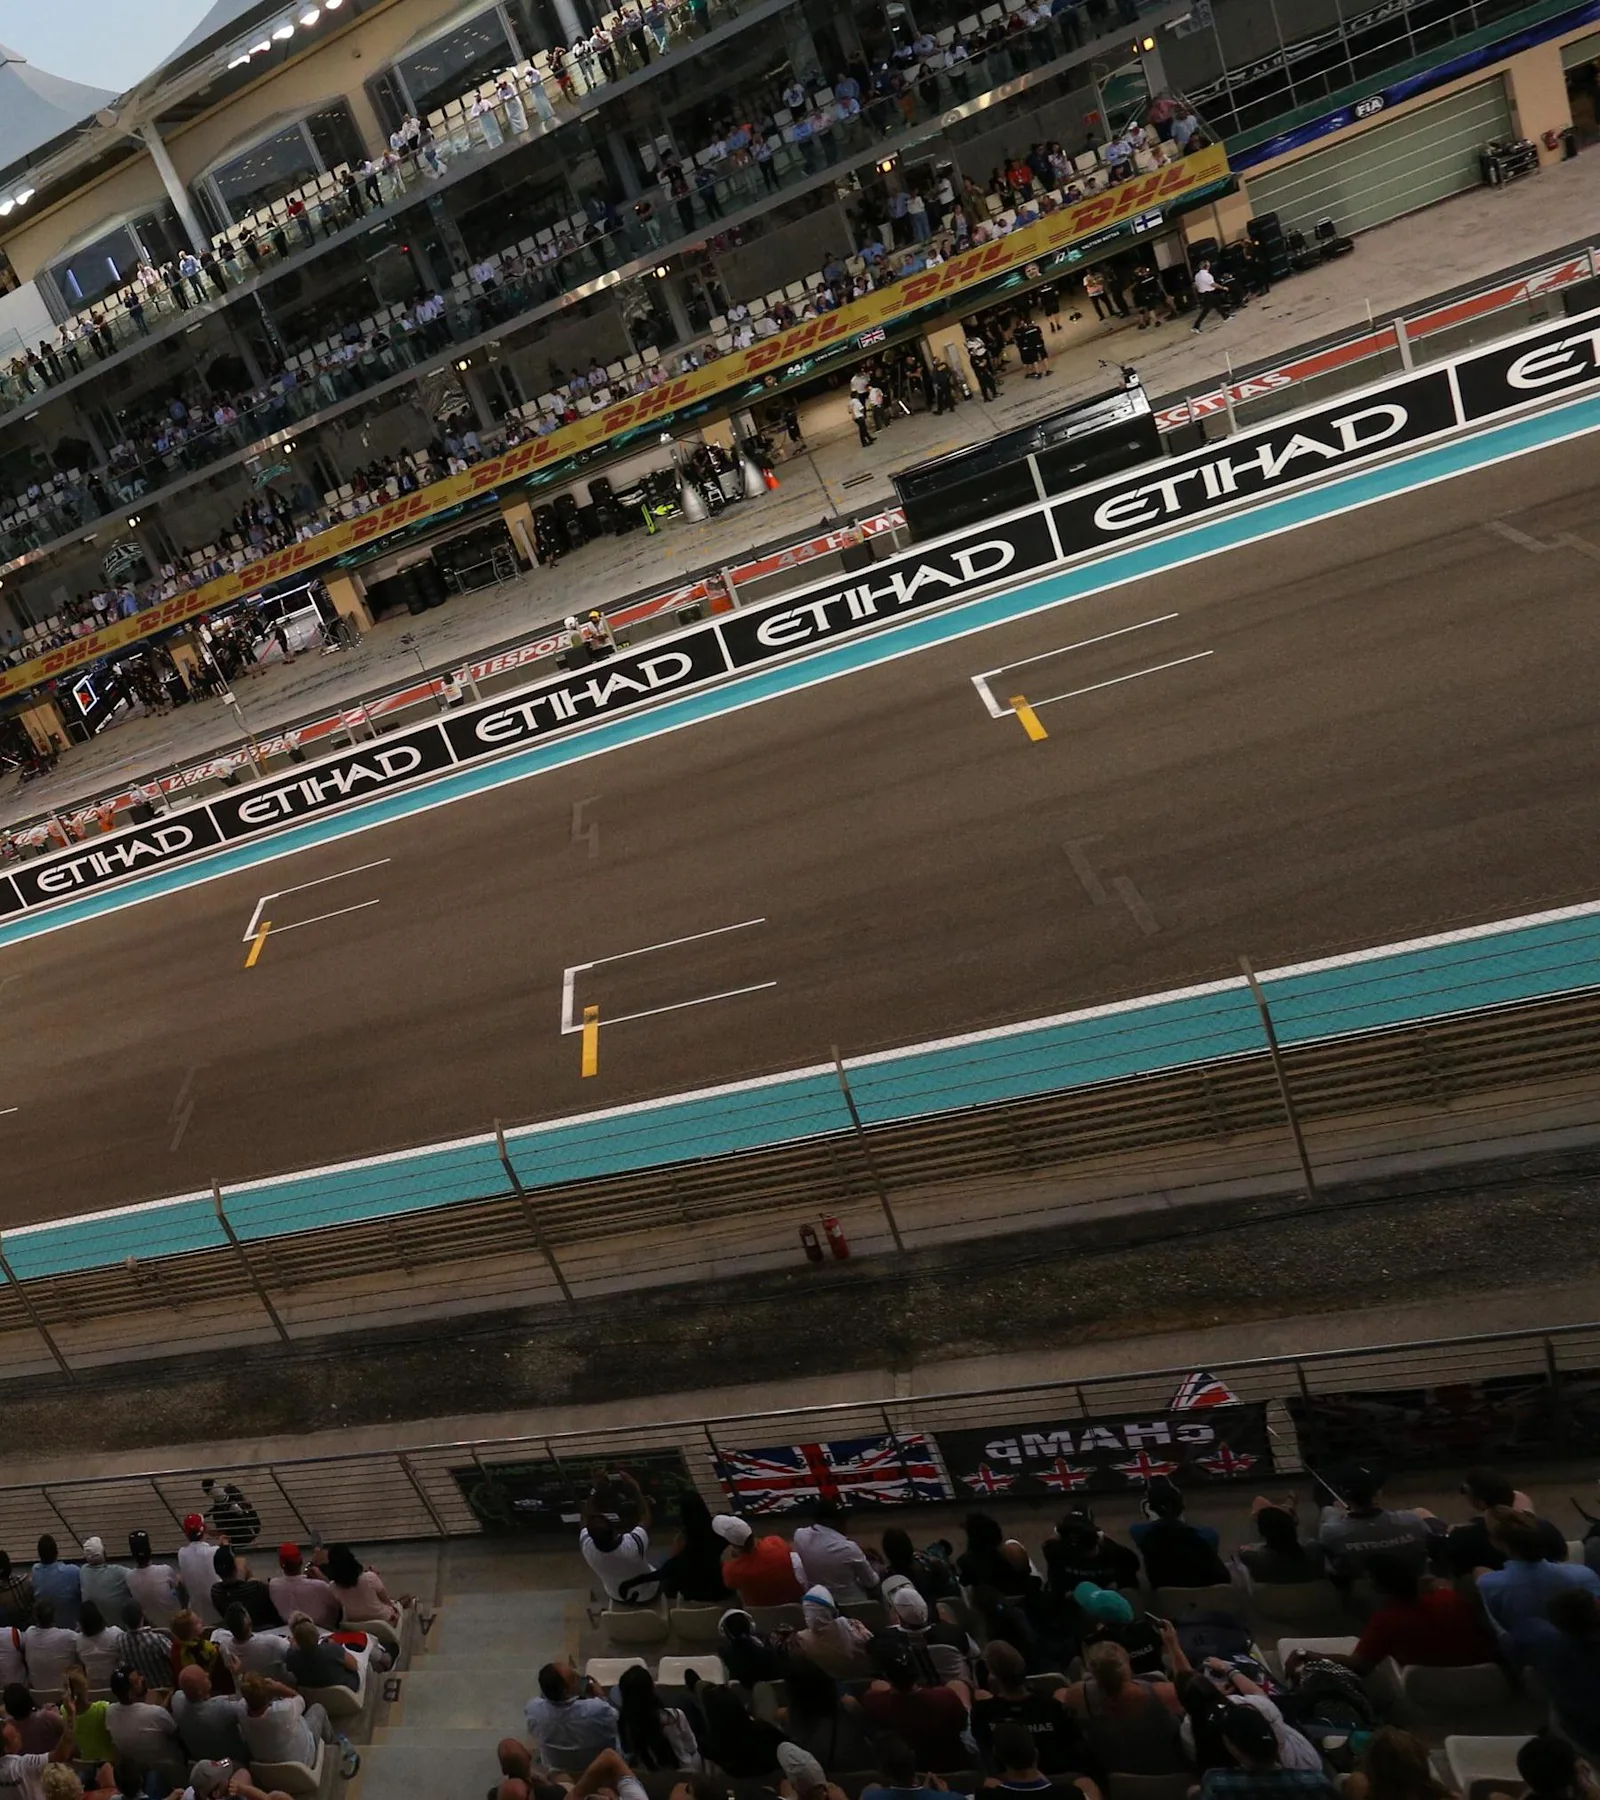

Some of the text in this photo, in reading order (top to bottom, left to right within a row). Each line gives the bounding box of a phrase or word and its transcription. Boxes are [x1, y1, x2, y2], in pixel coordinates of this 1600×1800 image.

[1357, 98, 1382, 116] FIA
[1071, 164, 1196, 235] DHL
[900, 242, 1014, 306] DHL
[744, 314, 849, 374] DHL
[602, 379, 698, 434] DHL
[470, 440, 558, 490] DHL
[1094, 403, 1408, 532] ETIHAD
[350, 493, 432, 543] DHL
[238, 544, 317, 591] DHL
[756, 540, 1016, 647] ETIHAD
[136, 591, 207, 634] DHL
[41, 637, 106, 674] DHL
[475, 651, 693, 742] ETIHAD
[238, 745, 422, 823] ETIHAD
[37, 825, 194, 892] ETIHAD
[1345, 1533, 1415, 1552] PETRONAS
